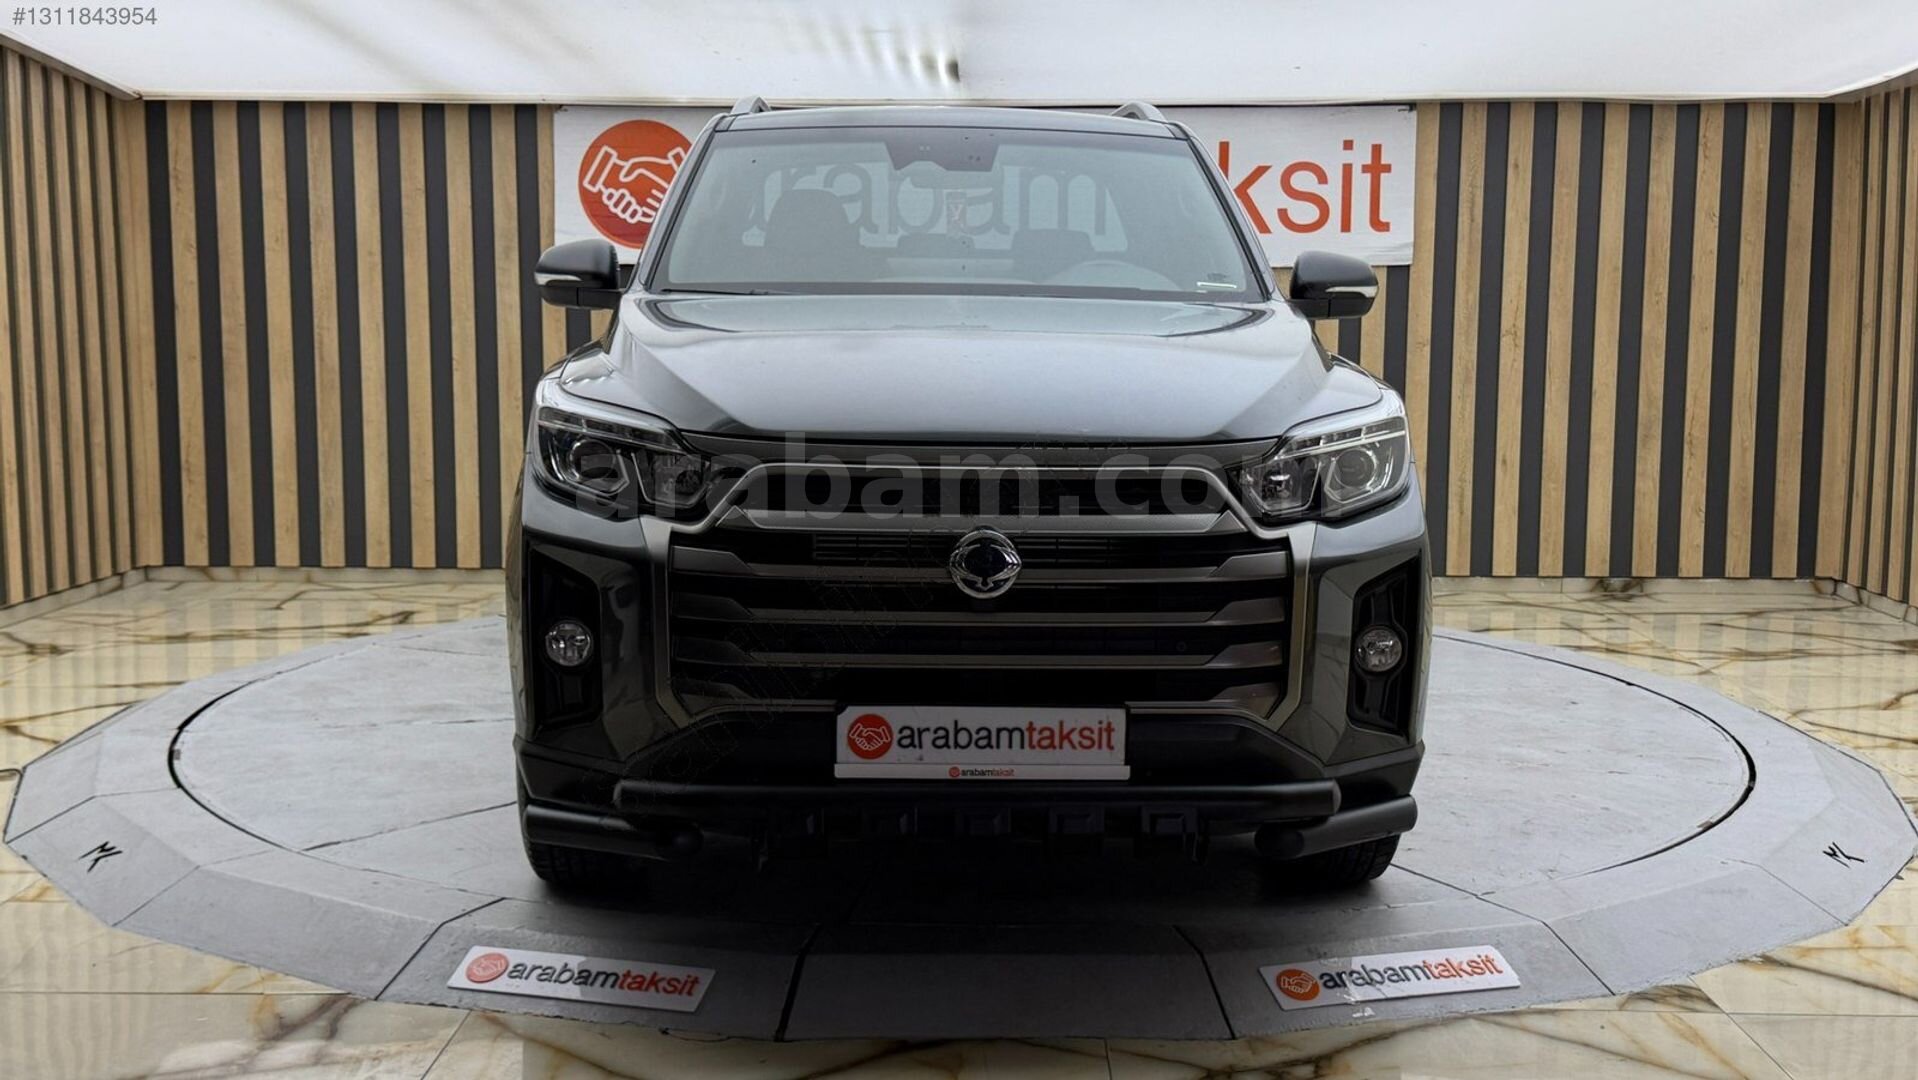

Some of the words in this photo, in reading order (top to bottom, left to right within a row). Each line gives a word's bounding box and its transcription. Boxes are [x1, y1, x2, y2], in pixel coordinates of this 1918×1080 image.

[897, 719, 1116, 751] arabamtaksit
[507, 962, 700, 997] arabamtaksit
[1318, 953, 1503, 990] arabamtaksit
